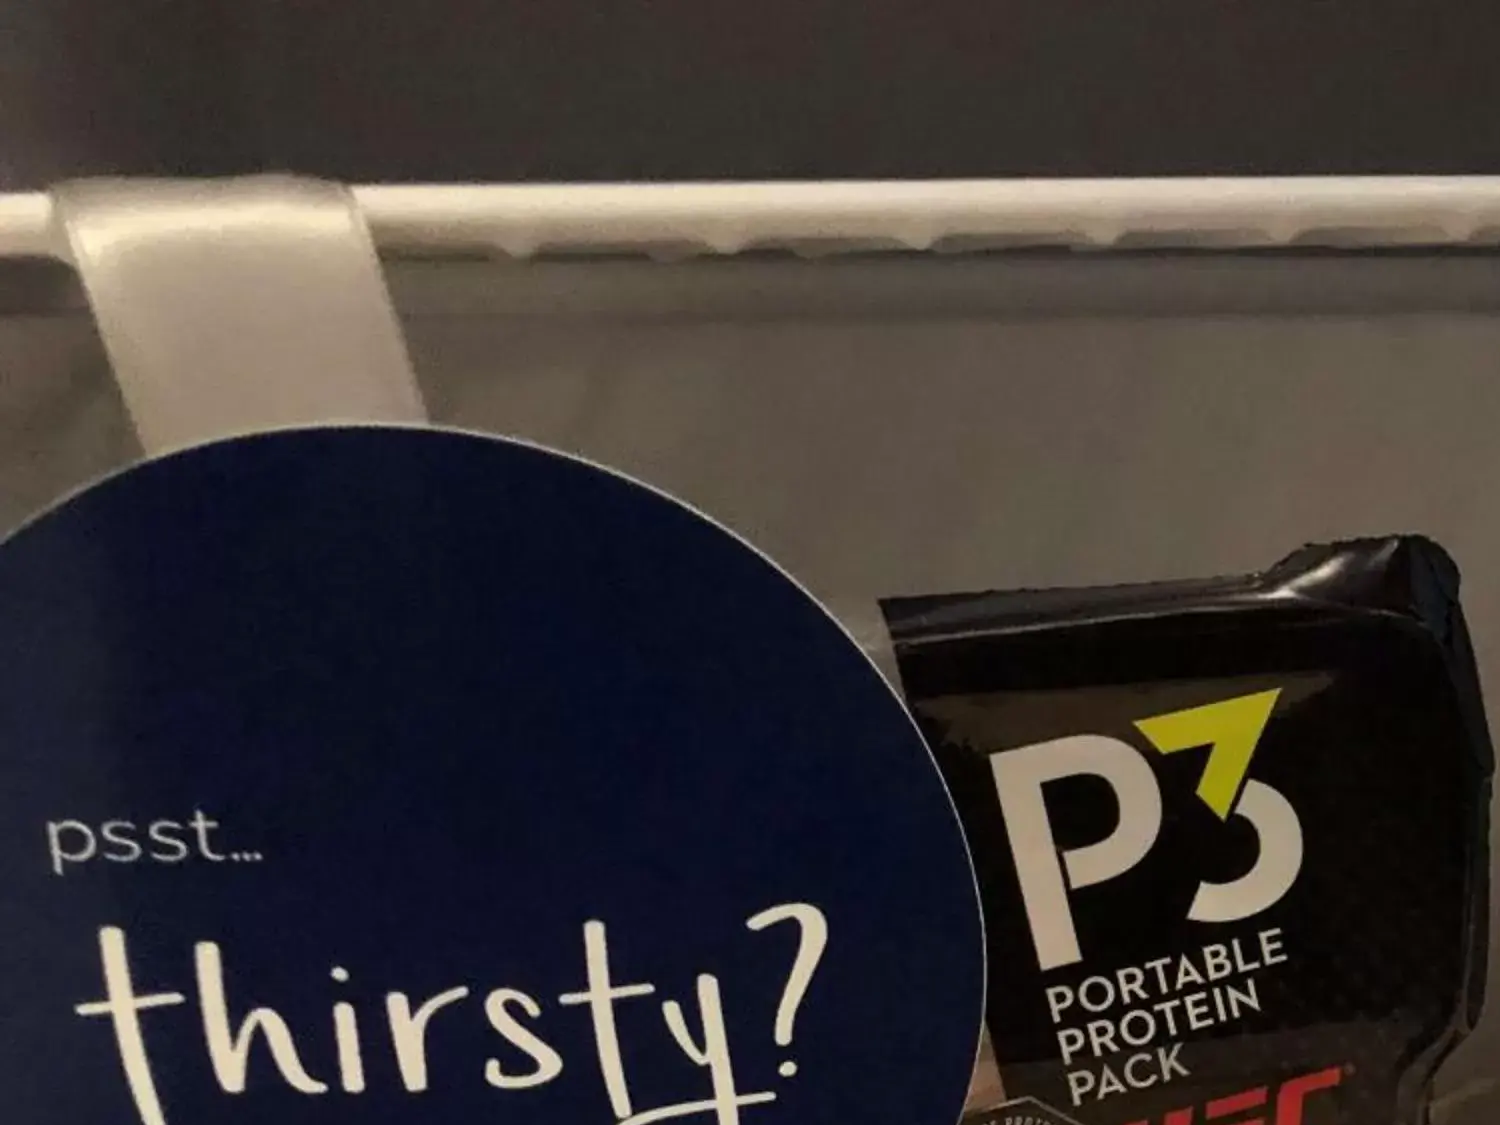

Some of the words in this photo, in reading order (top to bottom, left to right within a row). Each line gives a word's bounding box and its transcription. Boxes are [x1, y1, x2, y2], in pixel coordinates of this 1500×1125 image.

[47, 810, 263, 875] psst...
[989, 687, 1304, 972] P3
[1045, 927, 1289, 1024] PORTABLE
[1057, 978, 1262, 1066] PROTEIN
[1067, 1043, 1193, 1107] PACK
